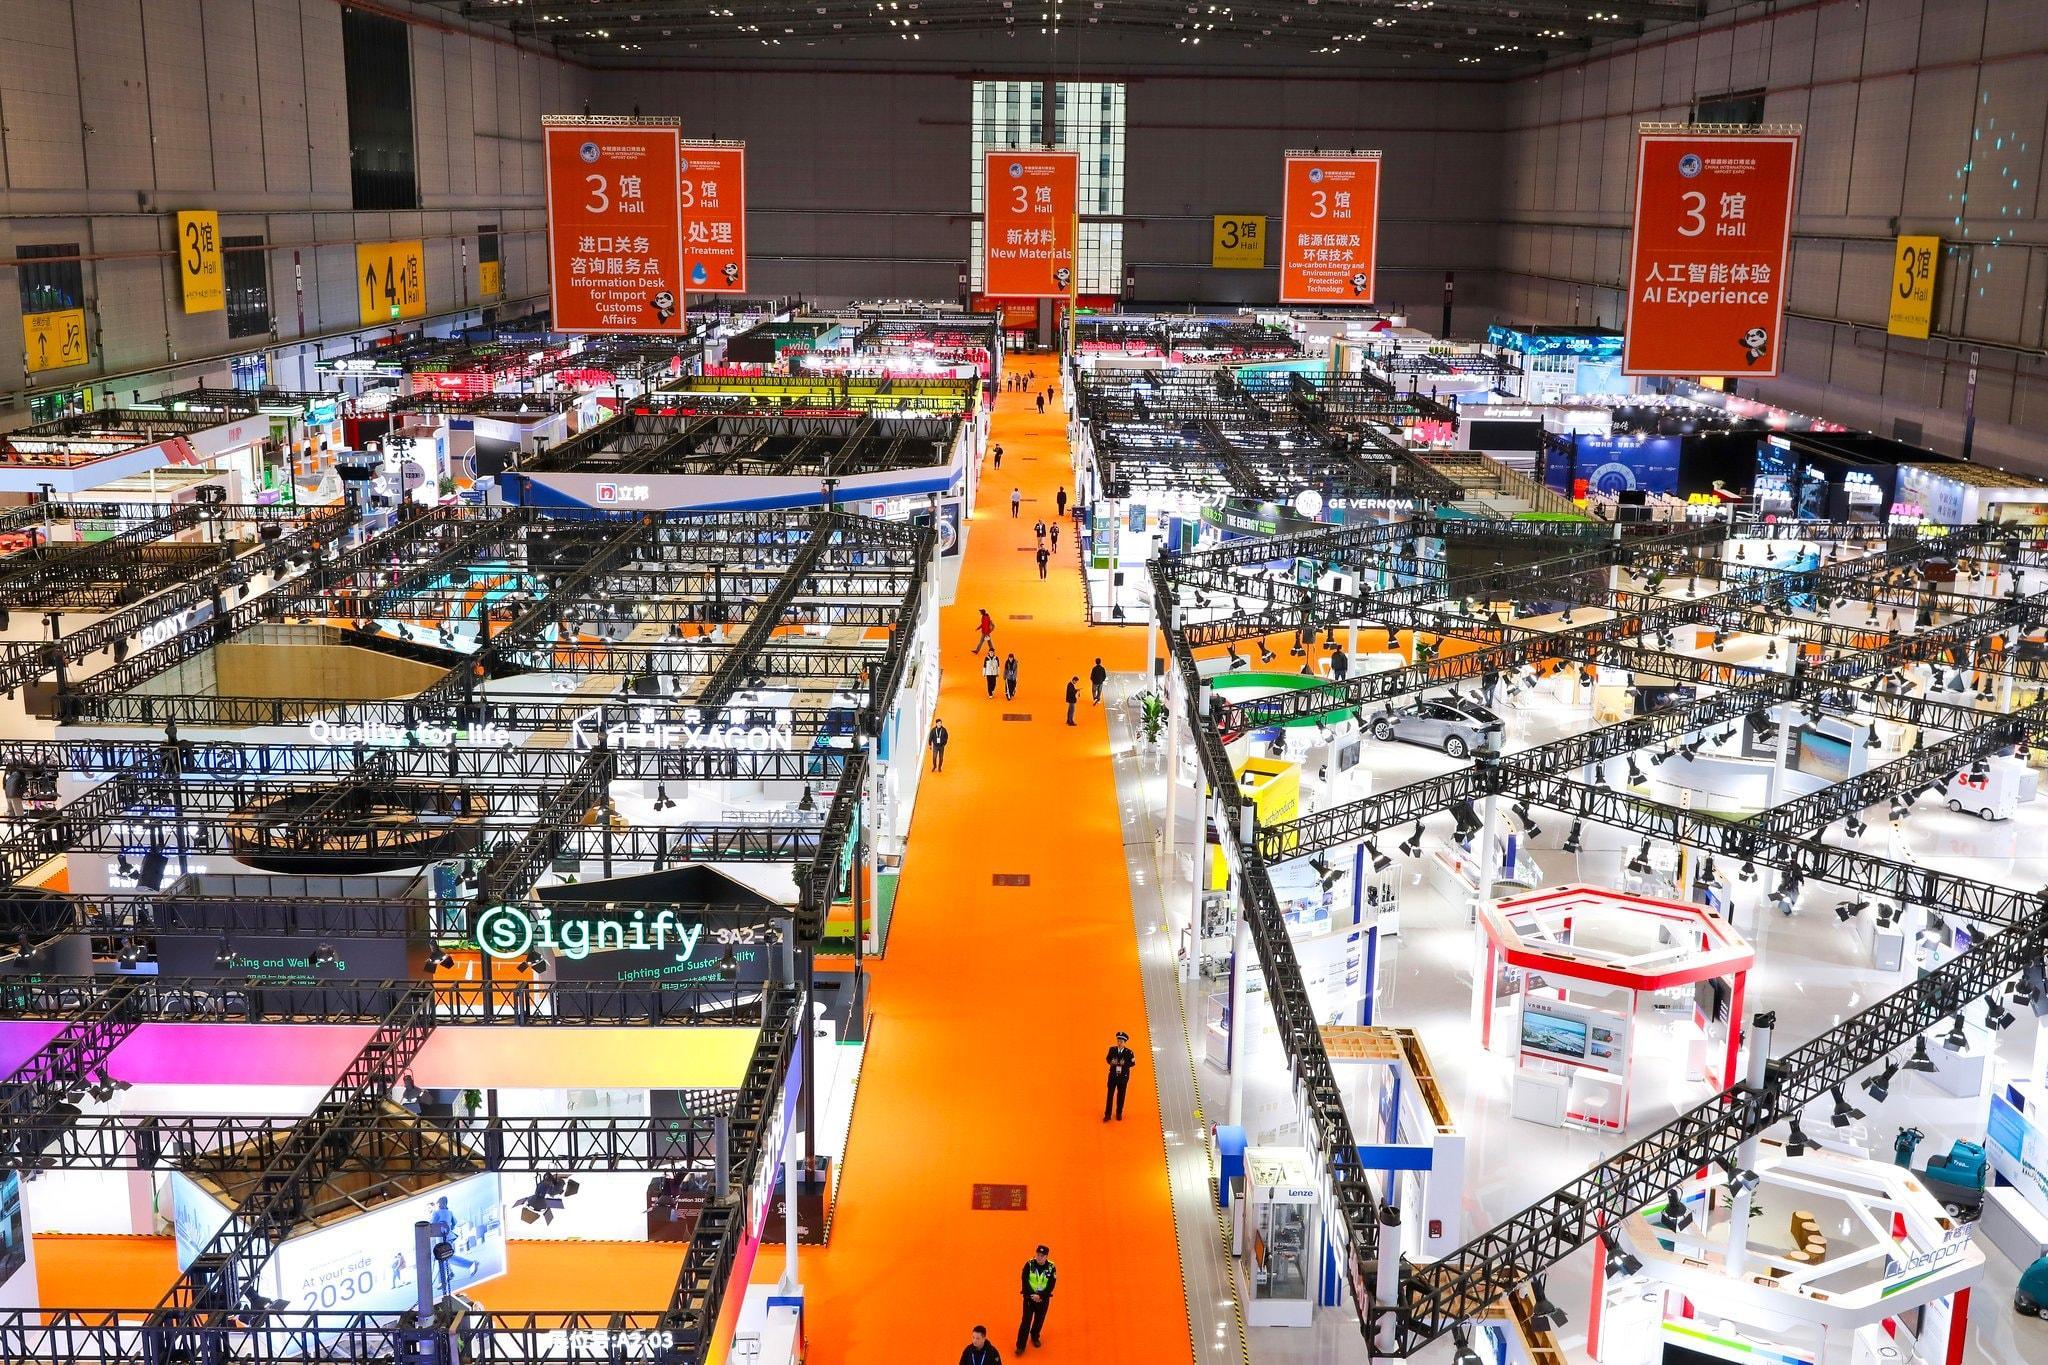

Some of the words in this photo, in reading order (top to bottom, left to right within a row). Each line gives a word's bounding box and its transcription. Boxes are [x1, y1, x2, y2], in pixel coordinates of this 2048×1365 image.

[585, 174, 609, 213] 3
[619, 175, 642, 199] 馆
[701, 181, 717, 198] 馆
[1035, 186, 1052, 203] 馆
[619, 201, 644, 213] Hall
[700, 200, 719, 208] Hall
[1011, 185, 1028, 213] 3
[1310, 191, 1328, 218] 3
[1334, 191, 1351, 208] 馆
[1719, 192, 1746, 220] 馆
[1034, 204, 1053, 213] Hall
[1333, 210, 1352, 218] Hall
[1677, 191, 1706, 237] 3
[200, 223, 214, 253] 馆
[682, 222, 733, 243] 处理
[1007, 228, 1056, 245] 新材料
[1221, 221, 1239, 249] 3
[1240, 222, 1257, 239] 馆
[1716, 223, 1746, 237] Hall
[186, 222, 202, 275] 3
[578, 236, 650, 254] 进口关务
[1240, 242, 1258, 250] Hall
[1298, 234, 1360, 247] 能源低碳及
[690, 246, 734, 255] Treatment
[991, 248, 1016, 259] New
[1019, 248, 1072, 259] Materials
[1304, 249, 1354, 262] 环保技术
[203, 261, 217, 275] Hall
[407, 254, 418, 289] 馆
[570, 257, 660, 275] 咨询服务点
[1302, 269, 1350, 277] Environmental
[1328, 262, 1350, 270] Energy
[1645, 262, 1771, 284] 人工智能体验
[1899, 246, 1916, 299] 3
[1916, 248, 1931, 281] 馆
[384, 256, 408, 306] 4.1
[571, 277, 636, 287] Information
[639, 277, 665, 288] Desk
[1306, 285, 1345, 294] Technology
[1308, 277, 1343, 285] Protection
[407, 290, 420, 304] Hall
[590, 290, 607, 300] for
[609, 290, 647, 302] Import
[1642, 287, 1662, 303] AI
[1667, 287, 1769, 307] Experience
[1913, 287, 1929, 301] Hall
[595, 302, 643, 312] Customs
[602, 314, 637, 325] Affairs
[617, 486, 650, 501] 立邦
[1328, 499, 1347, 509] GE
[1350, 499, 1414, 509] VERNOVA
[1226, 513, 1237, 527] THE
[1237, 516, 1260, 531] ENERGY
[140, 610, 189, 650] SONY
[309, 719, 408, 747] Quality
[416, 720, 457, 745] for
[468, 722, 511, 746] life
[639, 725, 792, 750] HEXAGON
[263, 957, 284, 968] and
[617, 967, 660, 981] Lighting
[663, 963, 684, 974] and
[1288, 1189, 1314, 1198] Lenze
[303, 1277, 315, 1290] At
[319, 1267, 345, 1283] your
[348, 1257, 372, 1272] side
[303, 1270, 374, 1317] 2030
